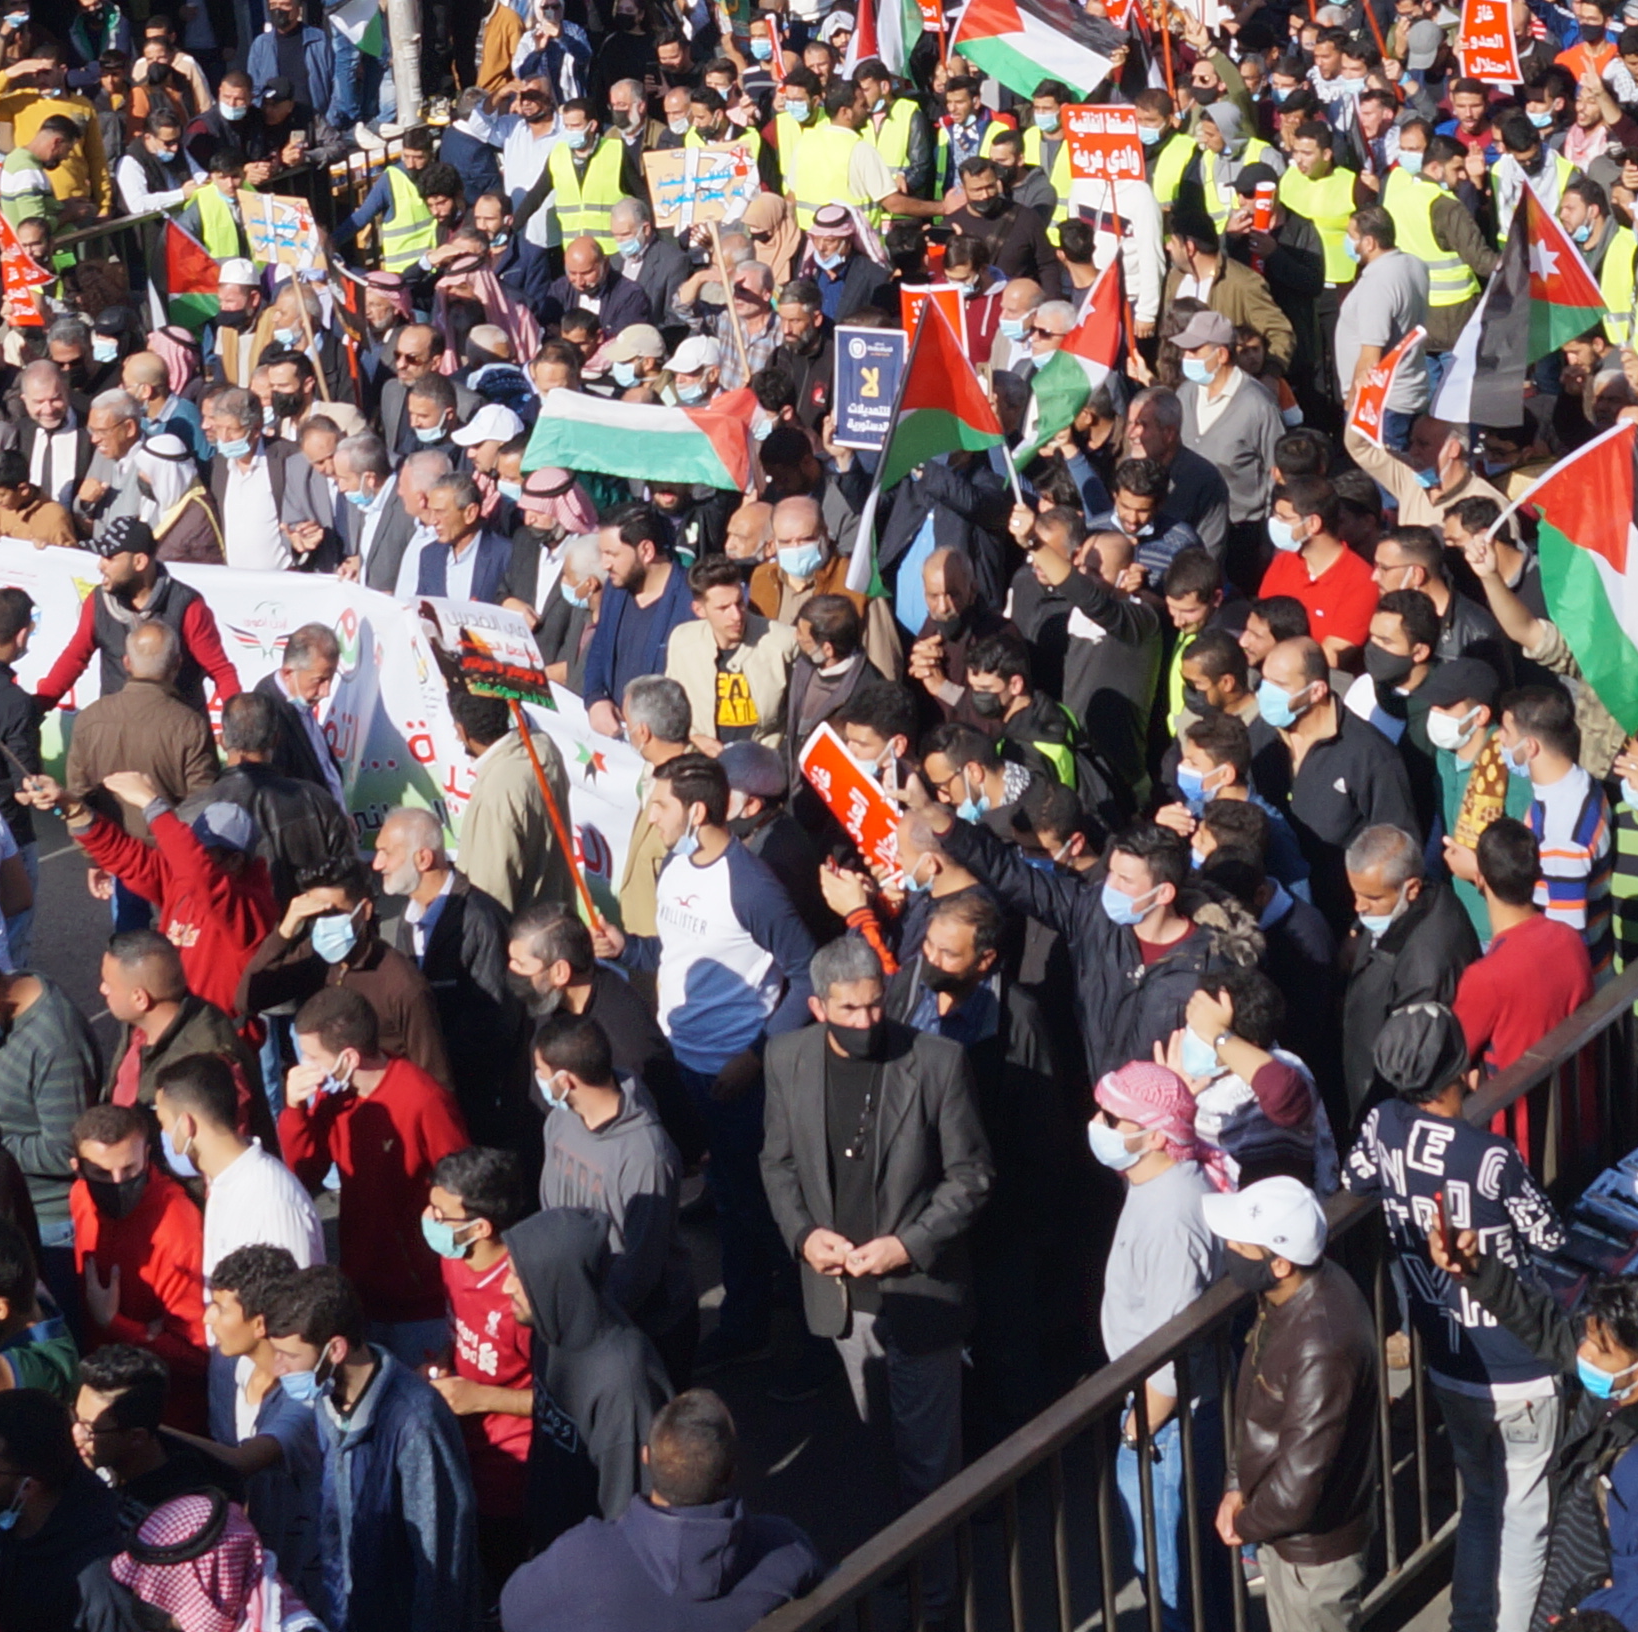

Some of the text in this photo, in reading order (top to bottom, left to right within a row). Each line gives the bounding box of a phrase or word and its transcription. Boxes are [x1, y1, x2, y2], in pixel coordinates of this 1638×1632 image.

[1474, 6, 1496, 26] غاز
[1468, 30, 1506, 51] العدو
[1469, 54, 1511, 76] احتلال
[1068, 110, 1104, 137] اتفاقية
[1072, 141, 1141, 180] وادي عربة
[859, 366, 880, 398] لا
[810, 764, 833, 803] غاز
[846, 788, 870, 841] العدو
[659, 904, 708, 936] HOLLISTER
